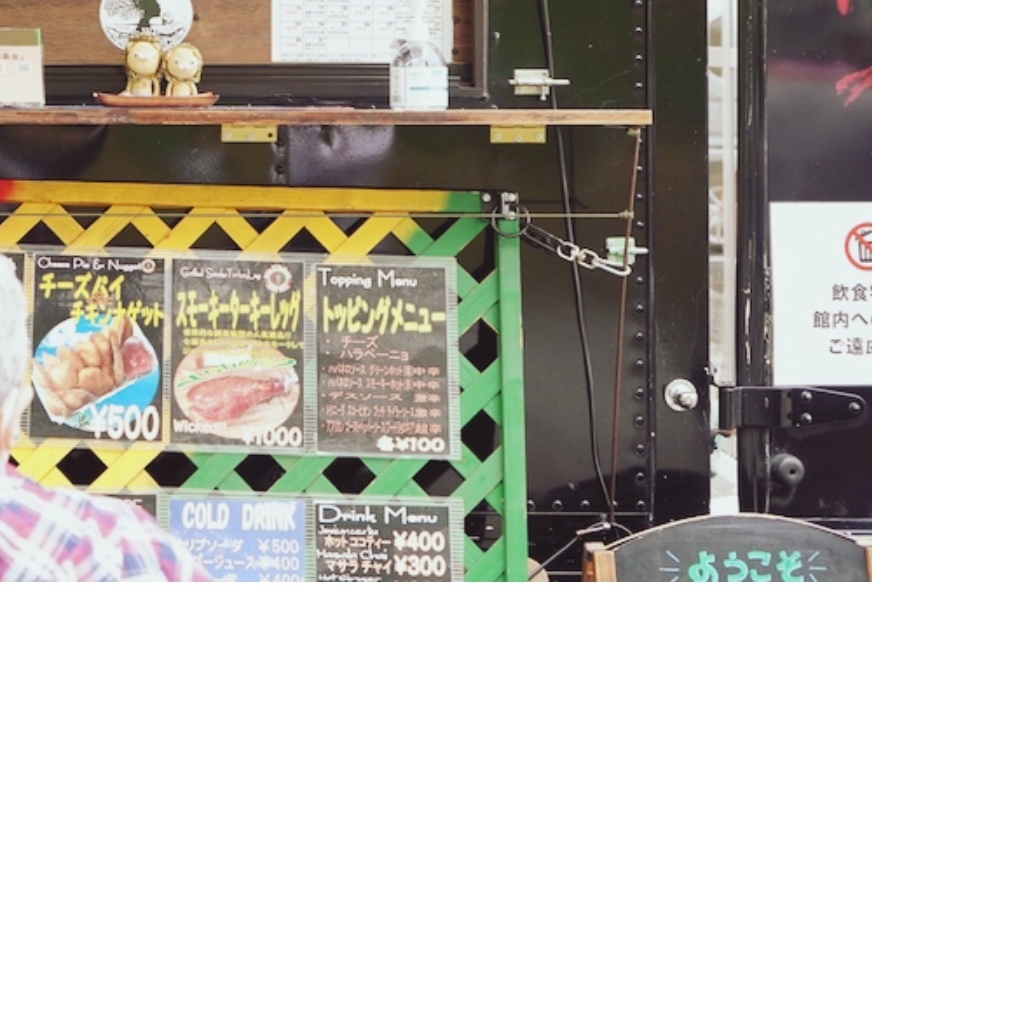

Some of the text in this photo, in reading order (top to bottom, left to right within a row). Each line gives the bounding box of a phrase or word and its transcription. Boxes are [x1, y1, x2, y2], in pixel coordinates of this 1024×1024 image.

[38, 271, 125, 299] チーズパイ
[316, 267, 418, 289] Topping Menu
[831, 282, 873, 302] 飲食
[69, 300, 165, 327] チキンナゲット
[175, 289, 302, 333] スモーキーターキーレッグ
[323, 295, 446, 335] トッピングメニュー
[812, 310, 873, 330] 館内へ
[339, 335, 379, 349] チーズ
[89, 404, 160, 440] ¥500
[242, 425, 303, 446] ¥1000
[181, 501, 298, 532] COLD DRINK
[318, 504, 438, 525] Drink Menu
[257, 538, 300, 554] ¥500
[392, 530, 446, 552] ¥400
[393, 555, 447, 577] ¥300
[687, 550, 806, 582] ようこそ
